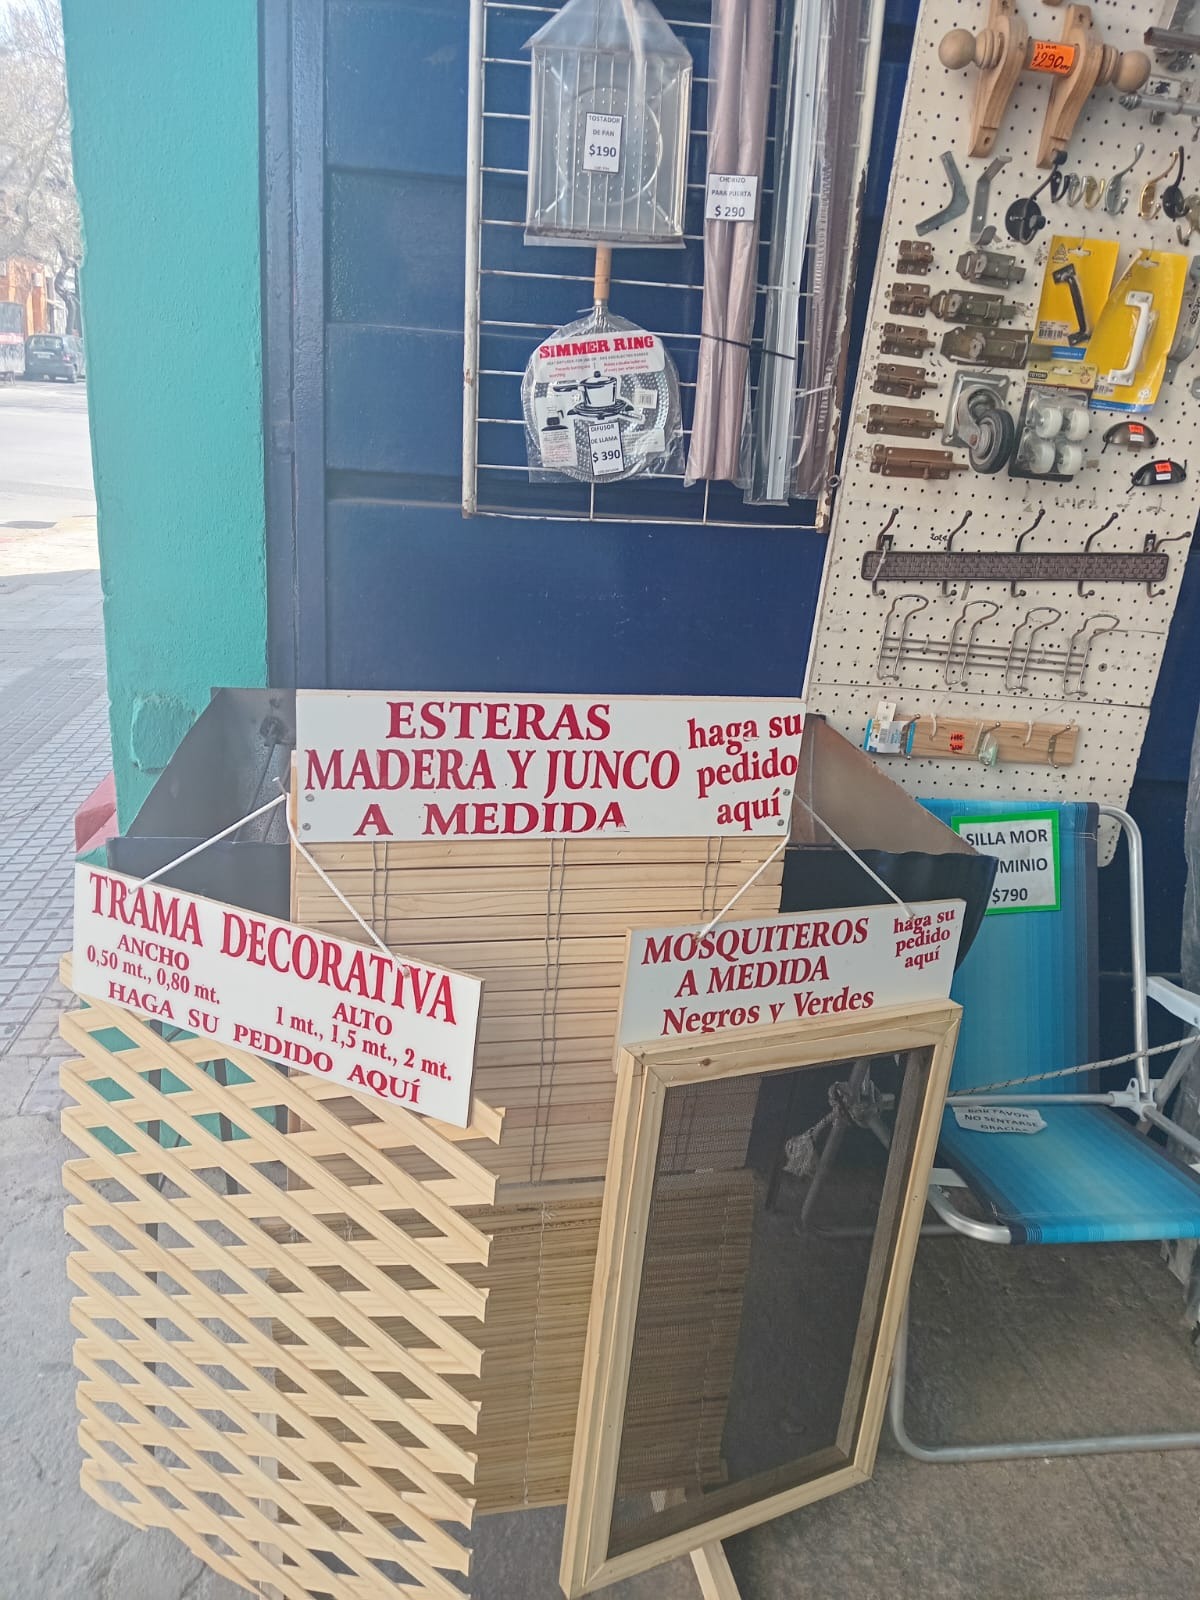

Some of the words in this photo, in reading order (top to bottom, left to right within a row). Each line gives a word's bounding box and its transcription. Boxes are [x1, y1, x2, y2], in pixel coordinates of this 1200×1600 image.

[589, 144, 617, 158] $190
[714, 204, 721, 217] $
[724, 206, 746, 218] 290
[539, 340, 610, 358] SIMMER
[614, 336, 654, 352] RING
[592, 452, 599, 463] $
[602, 450, 620, 460] 390
[385, 702, 611, 741] ESTERAS
[688, 716, 766, 755] haga
[768, 713, 804, 740] su
[304, 749, 496, 791] MADERA
[500, 750, 539, 790] Y
[544, 749, 680, 798] JUNCO
[697, 747, 798, 799] pedido
[353, 803, 393, 837] A
[422, 802, 628, 836] MEDIDA
[716, 788, 782, 832] aquí
[966, 831, 1006, 846] SILLA
[1010, 829, 1048, 844] MOR
[992, 888, 1028, 904] $790
[893, 915, 932, 935] haga
[936, 908, 956, 922] su
[89, 871, 204, 948] TRAMA
[220, 911, 457, 1025] DECORATIVA
[117, 934, 190, 971] ANCHO
[641, 917, 870, 965] MOSQUITEROS
[895, 927, 951, 957] pedido
[904, 945, 940, 970] aquí
[86, 944, 118, 972] 0,50
[123, 959, 152, 984] mt.,
[156, 967, 190, 994] 0,80
[195, 983, 220, 1005] mt.
[674, 970, 698, 998] A
[706, 956, 830, 994] MEDIDA
[332, 1002, 392, 1036] ALTO
[660, 1005, 760, 1036] Negros
[770, 1002, 785, 1024] y
[793, 986, 874, 1018] Verdes
[108, 980, 174, 1020] HAGA
[188, 1008, 219, 1034] SU
[233, 1023, 334, 1073] PEDIDO
[348, 1064, 420, 1103] AQUÍ
[276, 1006, 284, 1026] 1
[290, 1015, 324, 1040] mt.,
[332, 1029, 356, 1051] 1,5
[362, 1040, 397, 1067] mt.,
[405, 1048, 416, 1066] 2
[422, 1056, 453, 1081] mt.
